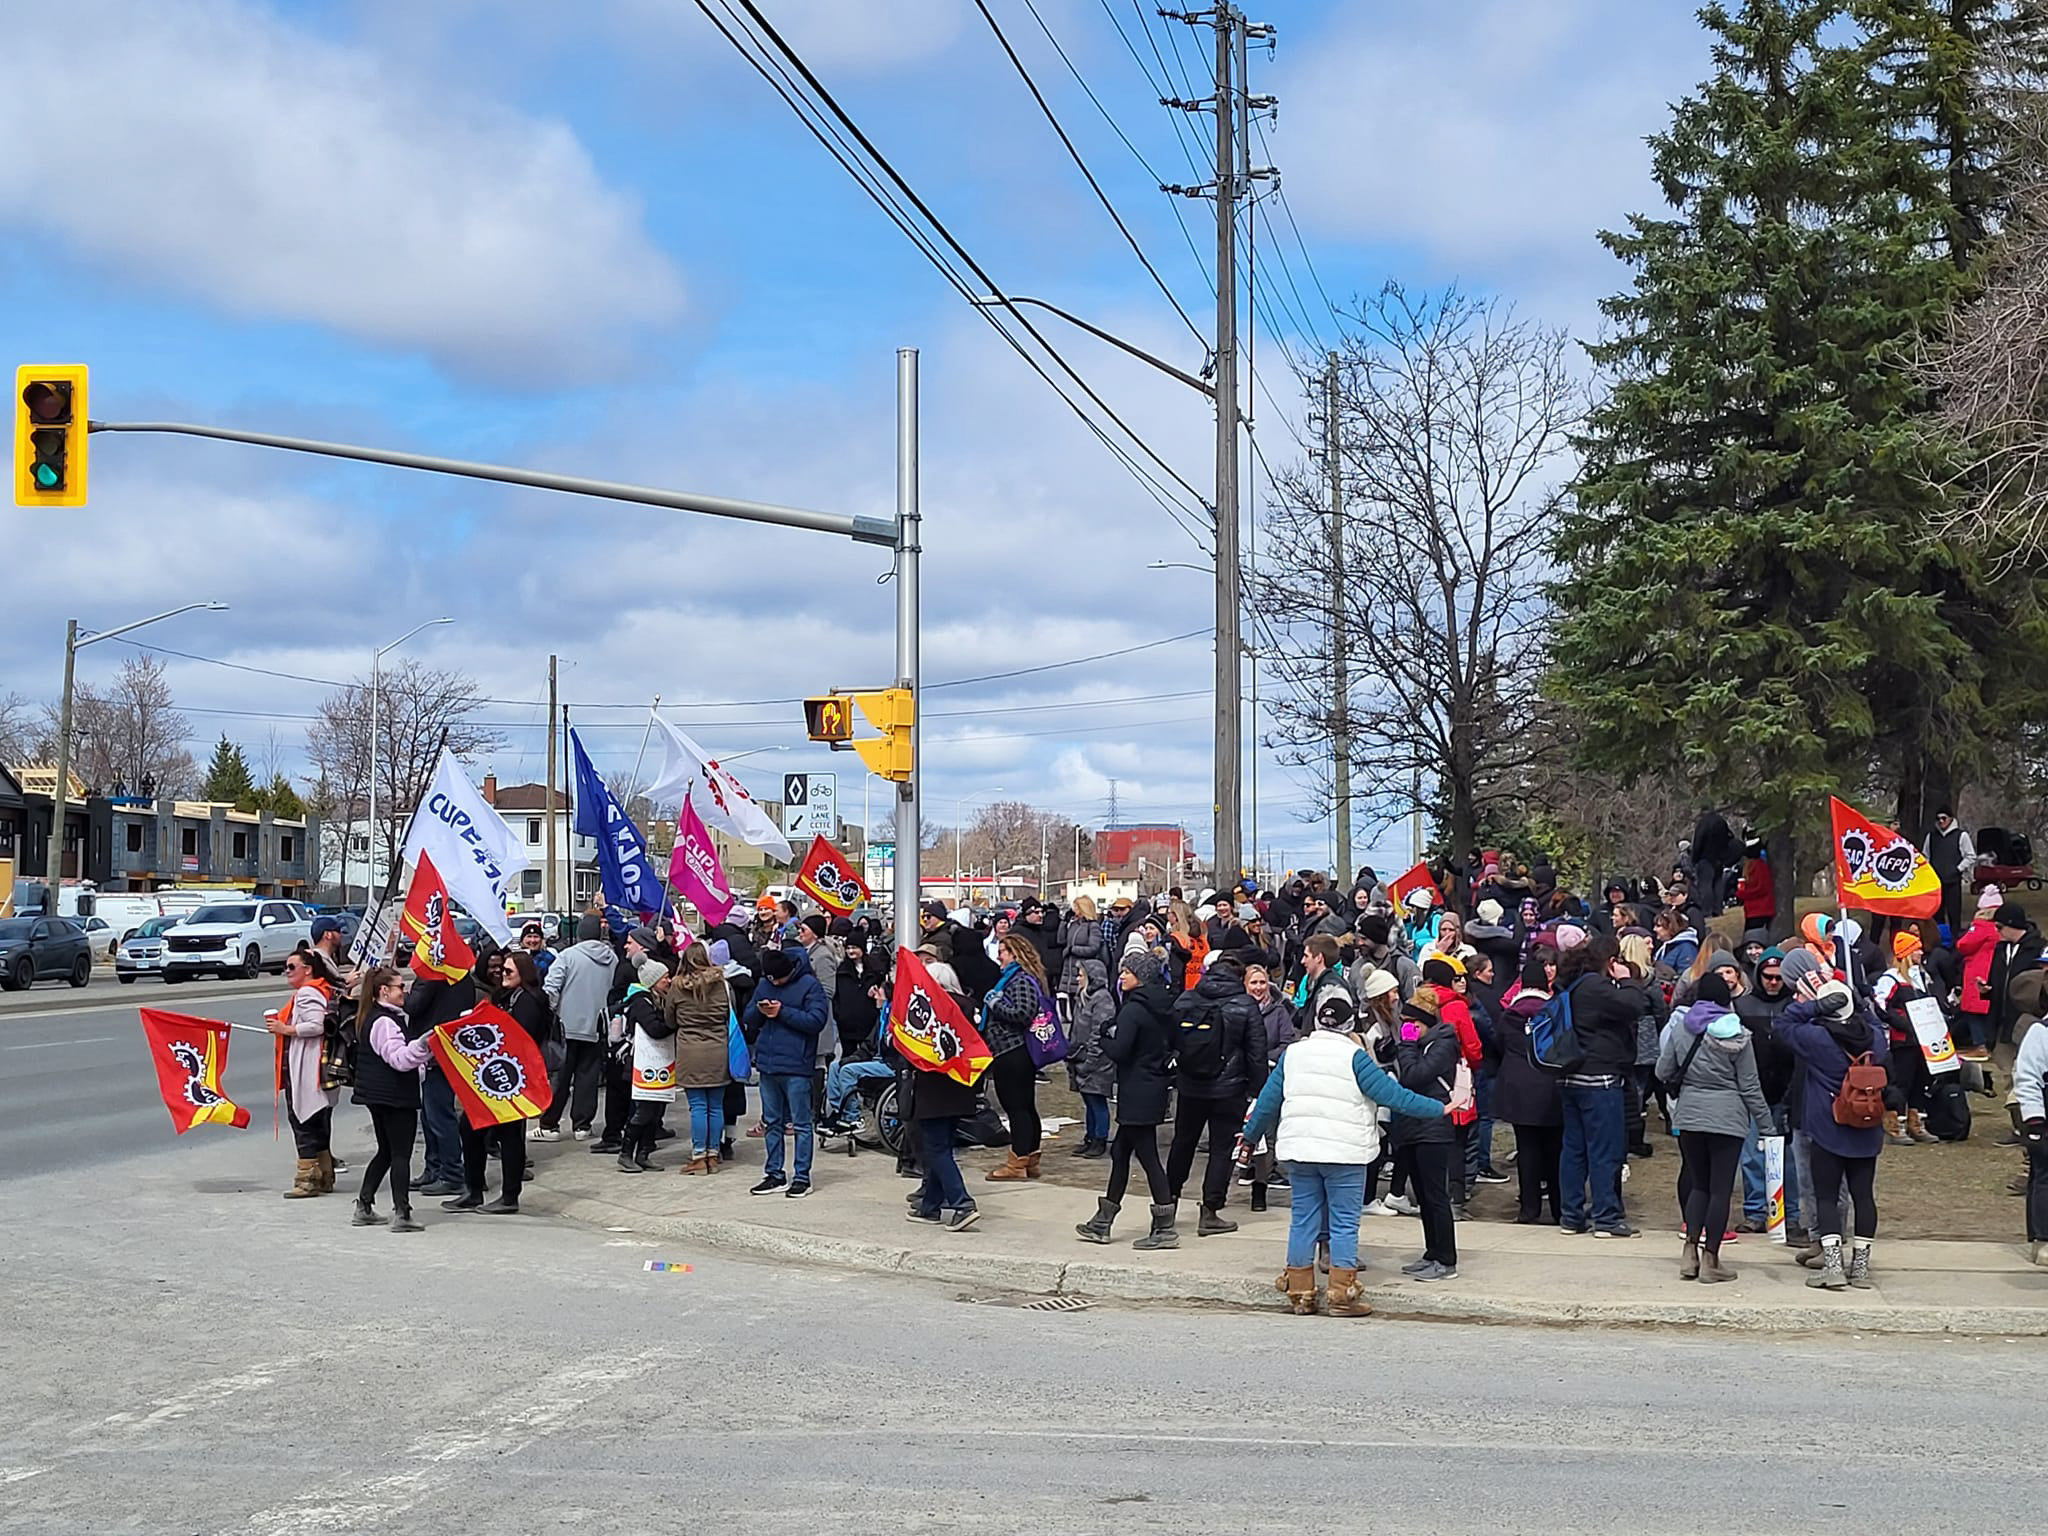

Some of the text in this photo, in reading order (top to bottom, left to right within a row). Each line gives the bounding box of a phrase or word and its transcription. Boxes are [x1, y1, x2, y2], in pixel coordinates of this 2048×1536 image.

[428, 792, 482, 845] CUPE
[1877, 855, 1910, 873] AFPC
[488, 1062, 513, 1092] AFPC
